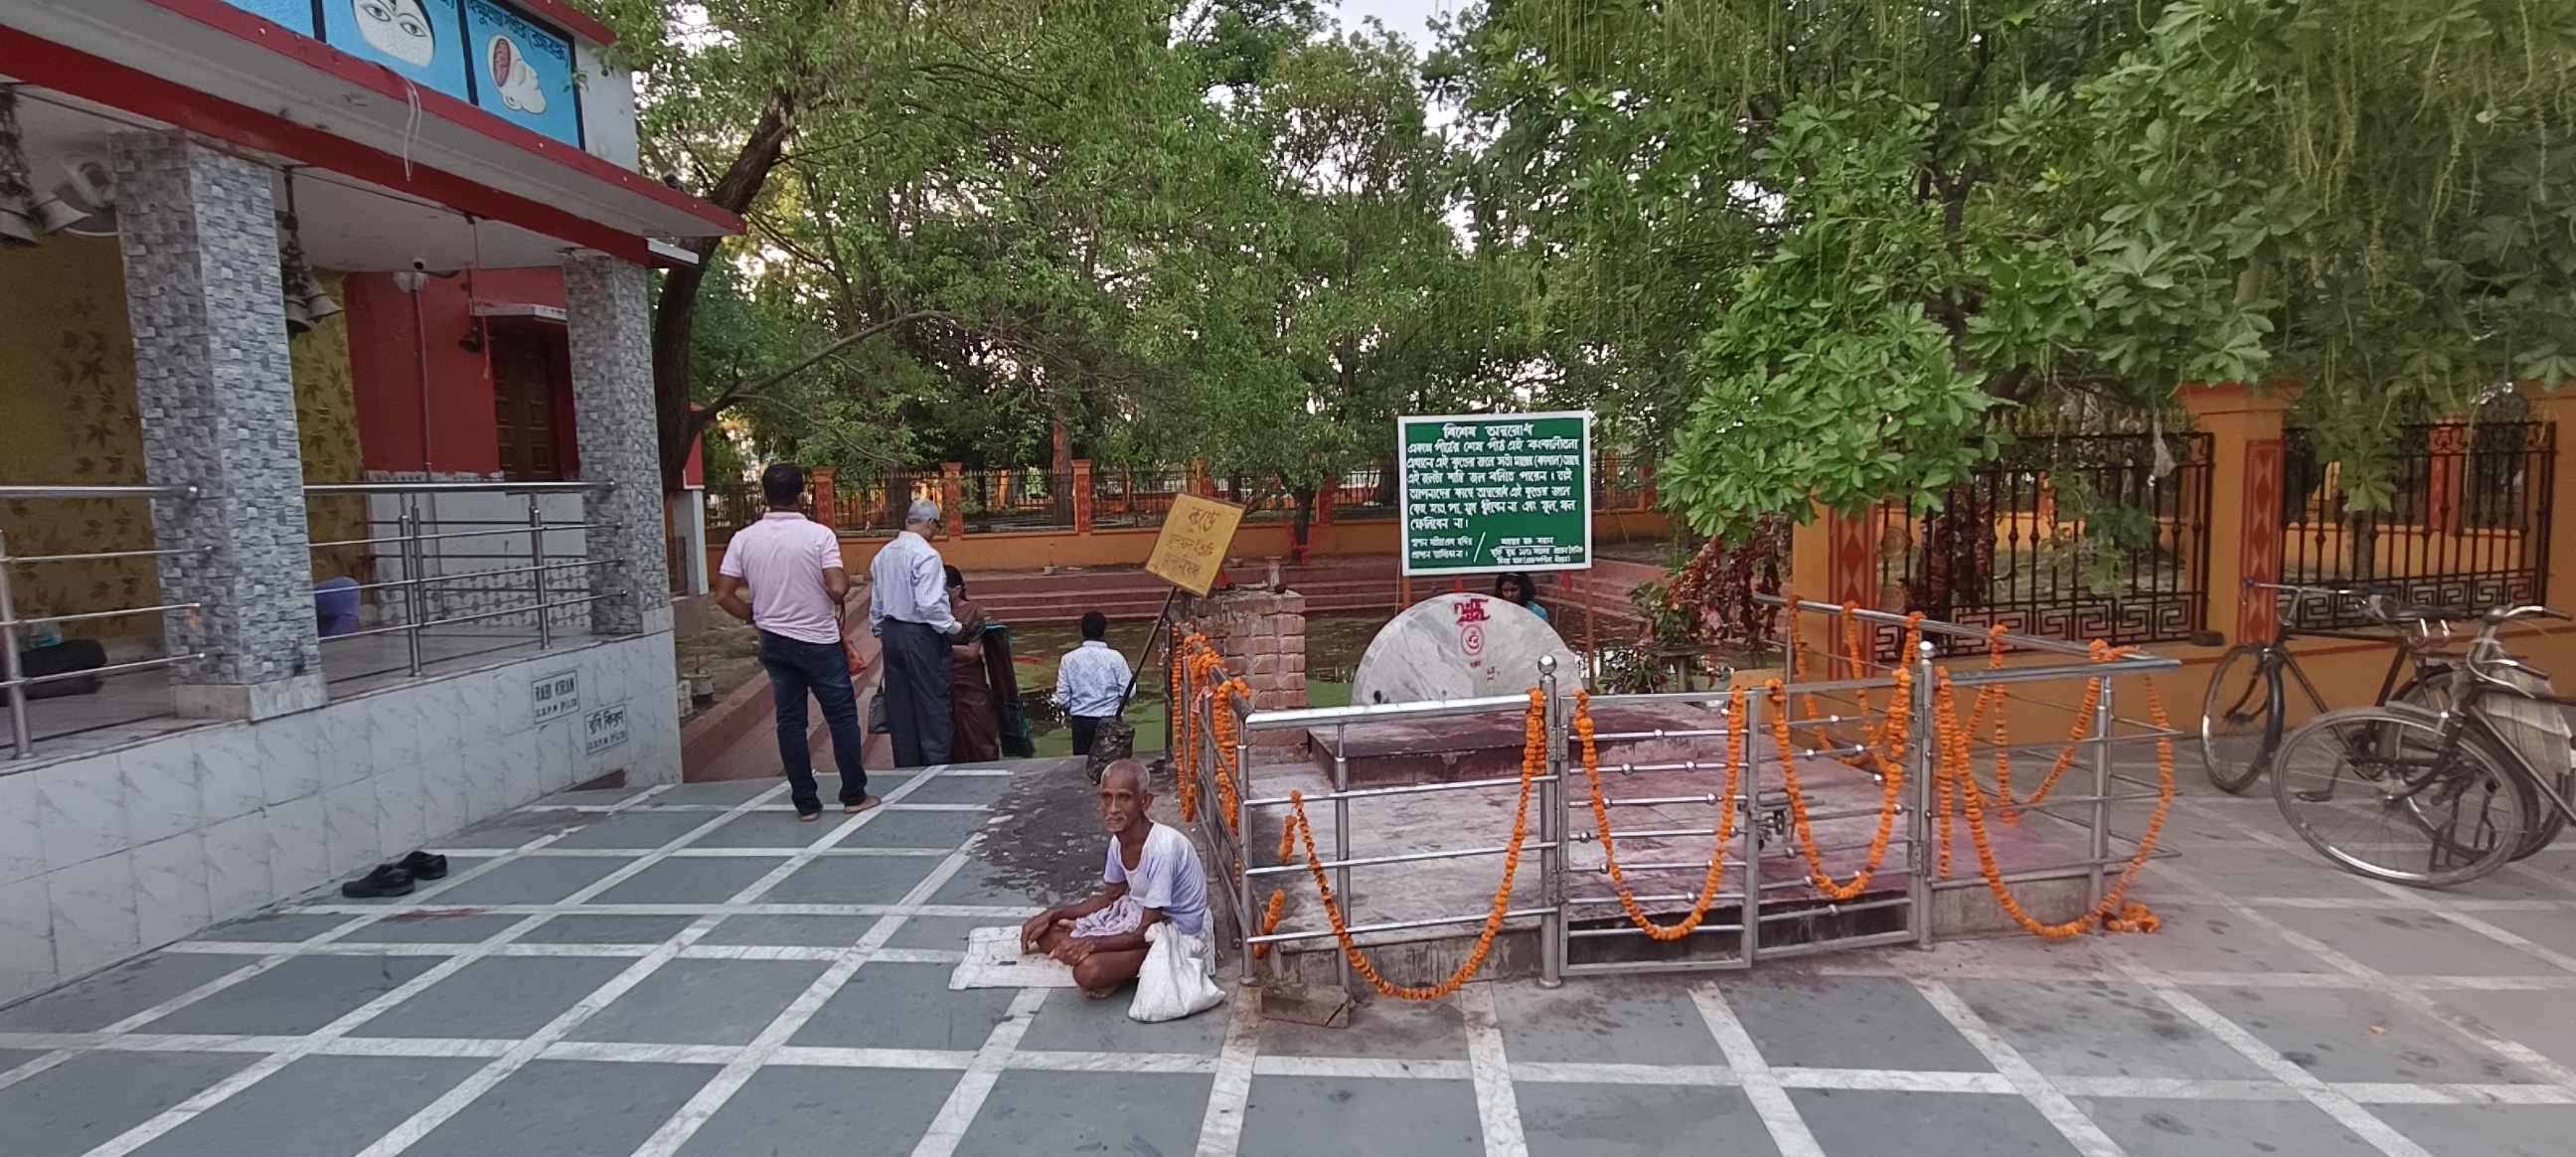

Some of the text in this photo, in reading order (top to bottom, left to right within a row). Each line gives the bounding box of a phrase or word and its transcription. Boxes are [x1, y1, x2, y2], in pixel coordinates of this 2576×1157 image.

[1442, 422, 1477, 438] বিশেষ
[1464, 441, 1485, 452] শেষ
[1508, 437, 1524, 451] এই
[1435, 452, 1449, 469] এই
[1407, 469, 1420, 485] এই
[1510, 482, 1523, 497] এই
[536, 684, 552, 702] RABI
